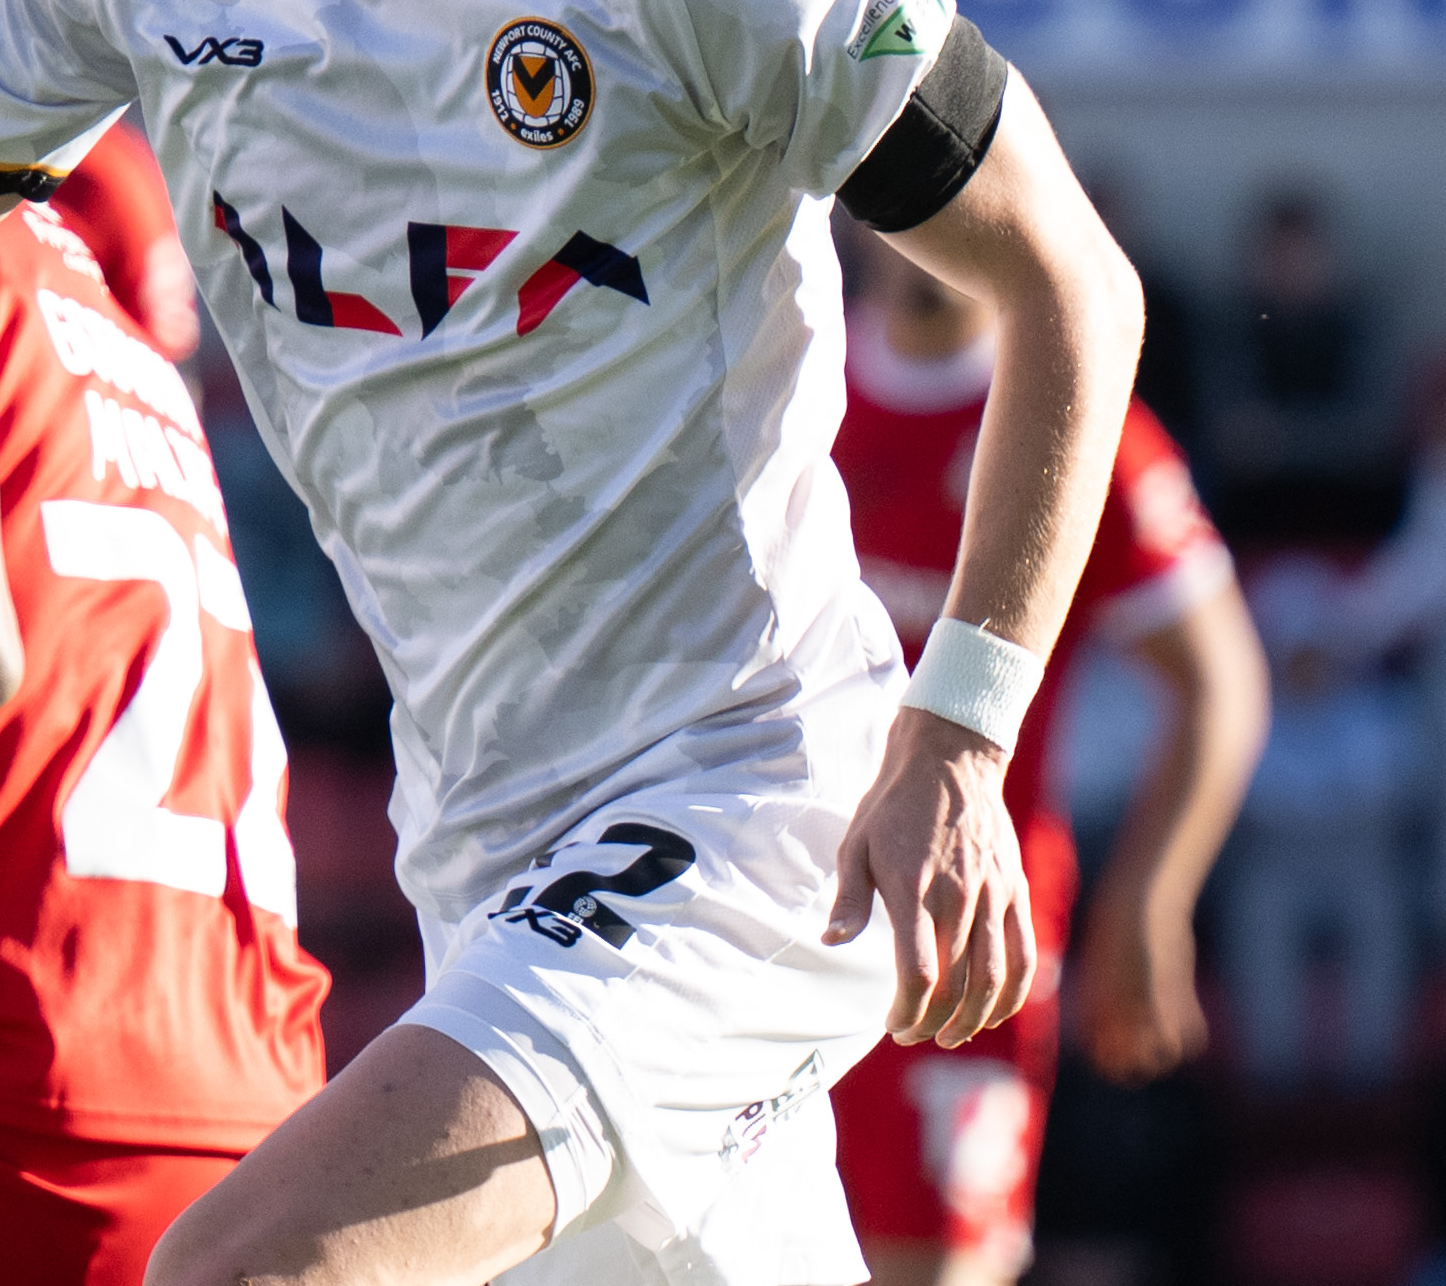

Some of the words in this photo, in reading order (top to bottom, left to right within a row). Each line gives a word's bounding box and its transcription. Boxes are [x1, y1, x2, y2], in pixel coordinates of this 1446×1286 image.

[163, 34, 265, 67] VX3
[493, 25, 526, 64] NEWPORT
[527, 25, 567, 50] COUNTY
[564, 49, 582, 72] AFC
[491, 89, 510, 123] 1912
[564, 98, 585, 128] 1989
[520, 128, 554, 143] exiles
